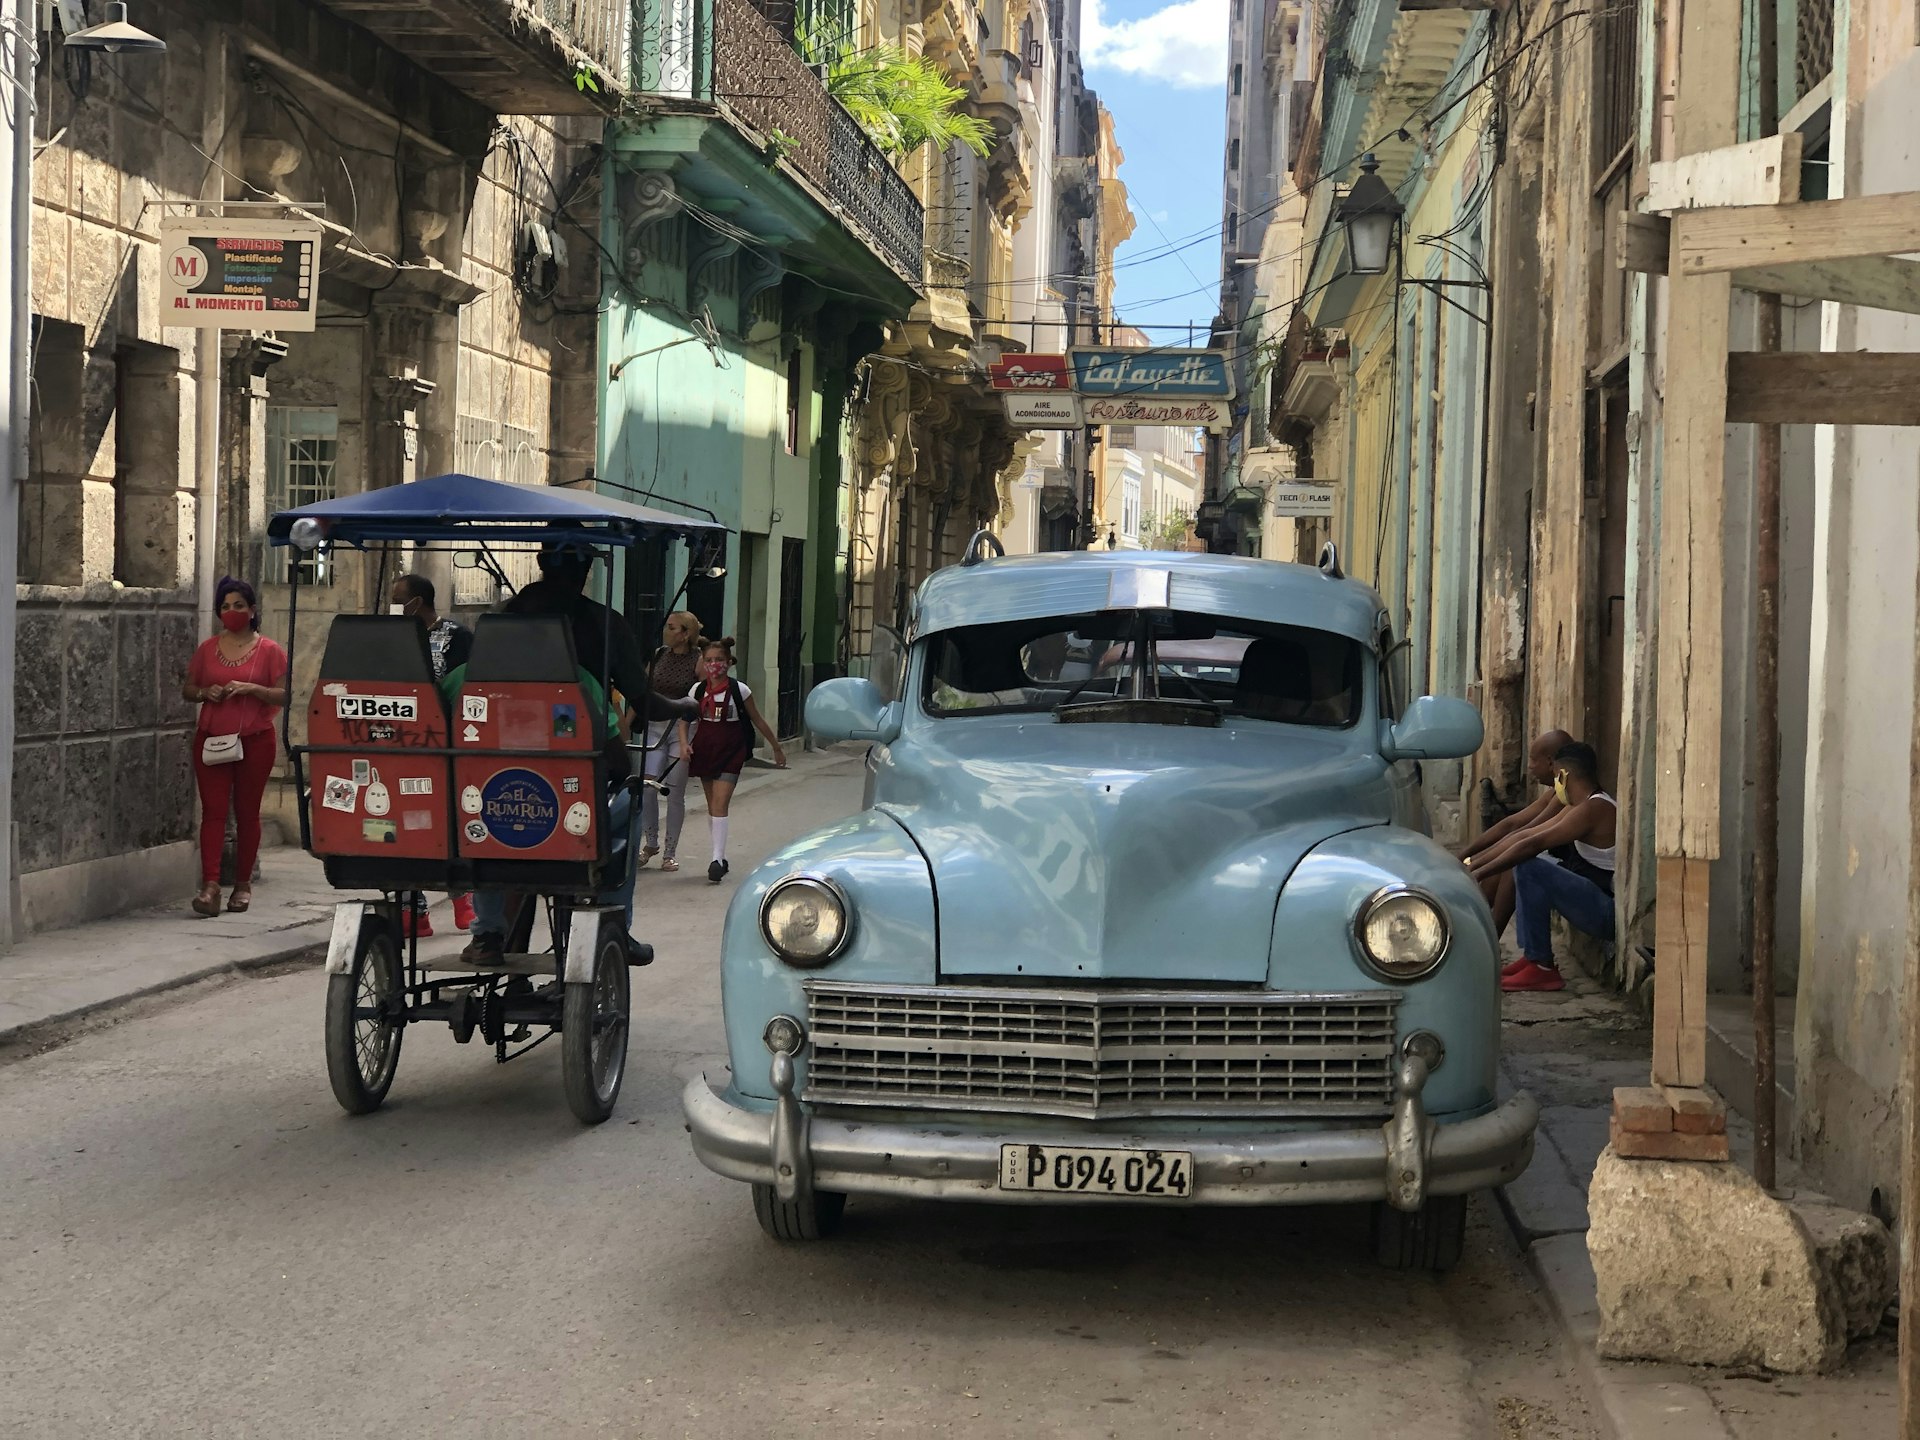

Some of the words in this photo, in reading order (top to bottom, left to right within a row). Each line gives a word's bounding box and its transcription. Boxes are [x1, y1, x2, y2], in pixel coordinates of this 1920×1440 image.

[216, 237, 284, 251] SERVICIOS
[224, 253, 283, 264] Plastificado
[174, 256, 198, 277] M
[224, 263, 278, 274] Fotocopias
[224, 274, 272, 284] Impresión
[224, 284, 263, 295] Montaje
[174, 297, 190, 309] AL
[195, 298, 264, 311] MOMENTO
[272, 297, 299, 309] Foto
[1015, 410, 1071, 418] ACONDICIONADO
[1085, 399, 1219, 422] Restaurante
[362, 699, 413, 718] Beta
[1009, 1150, 1017, 1183] CUBA
